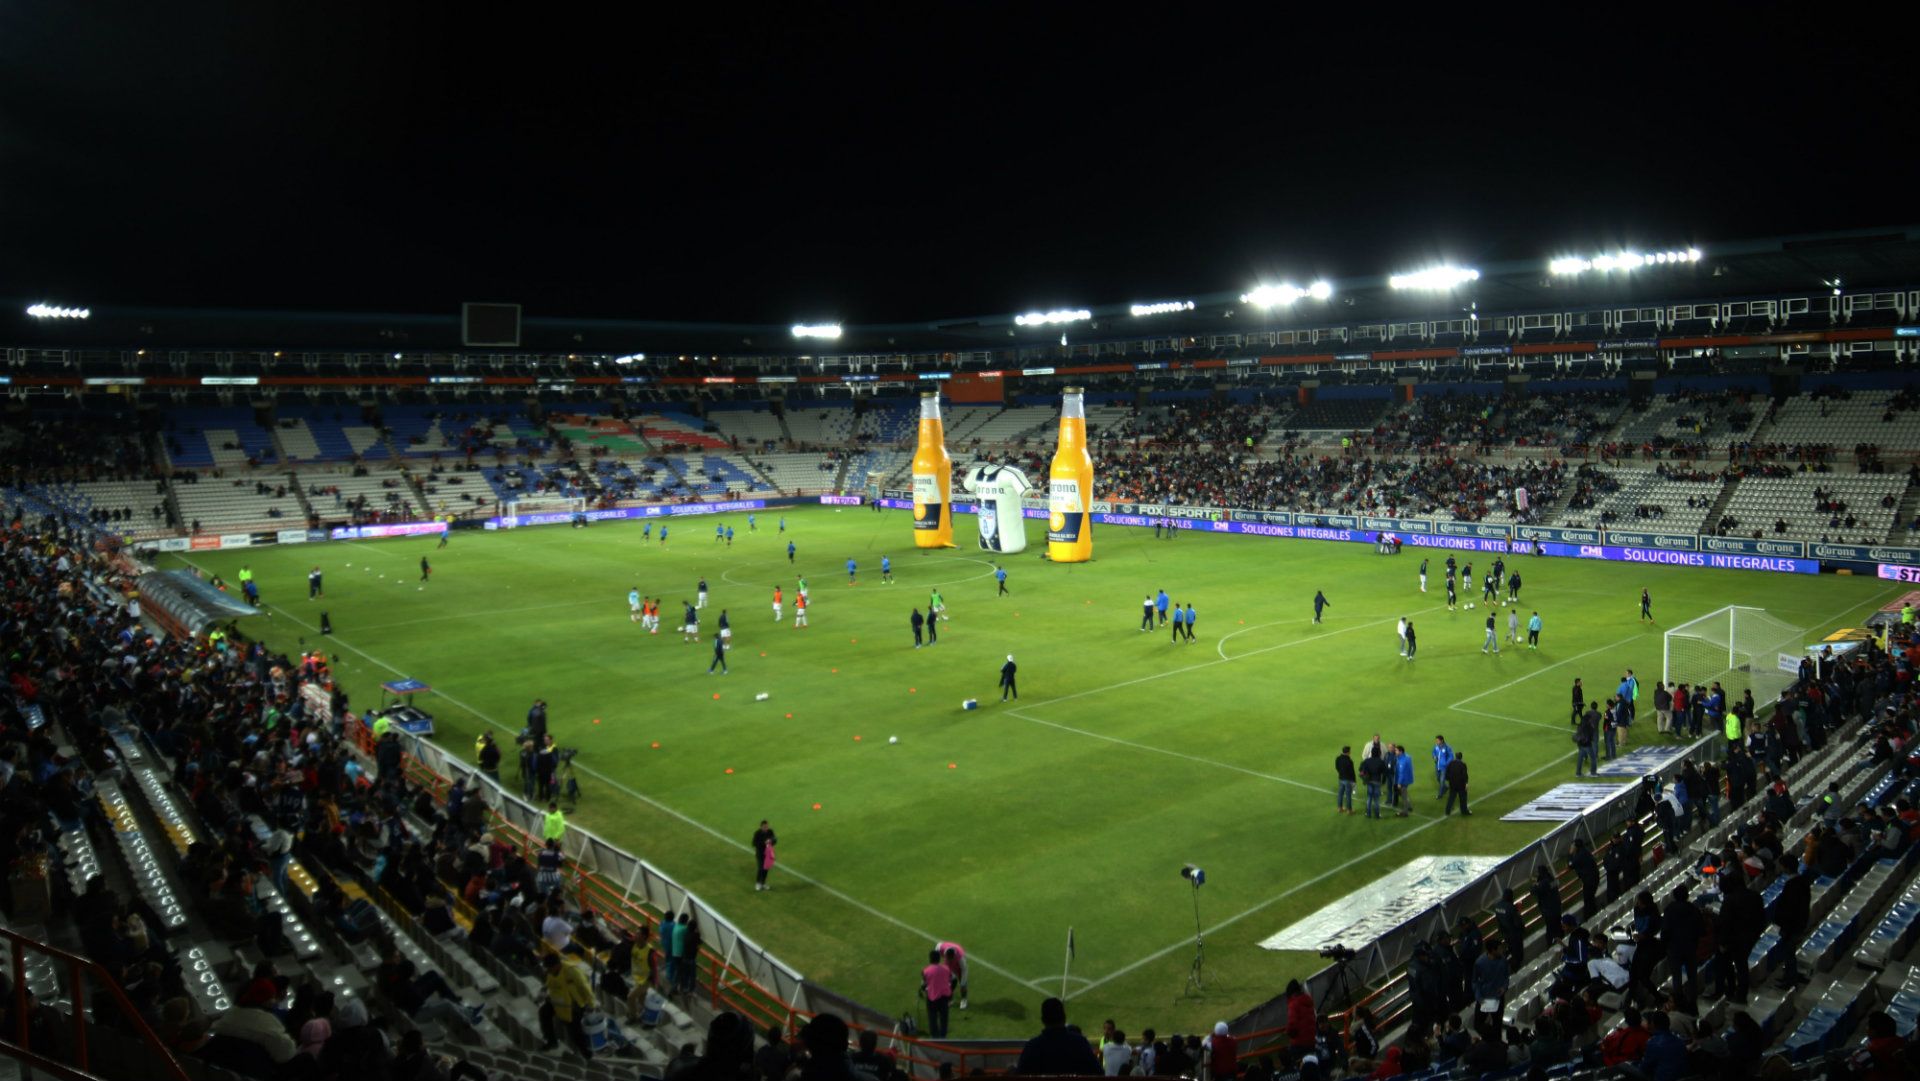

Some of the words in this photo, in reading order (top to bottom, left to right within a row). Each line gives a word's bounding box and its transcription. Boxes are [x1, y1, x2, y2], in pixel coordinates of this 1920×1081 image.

[1139, 505, 1163, 516] FOX
[1103, 514, 1145, 526] SOLUCIONES
[1400, 520, 1426, 531] Corona
[1242, 523, 1293, 536] SOLUCIONES
[1297, 527, 1350, 541] INTEGRALES
[1440, 523, 1468, 533] Corona
[1477, 525, 1506, 535] Corona
[1562, 530, 1594, 542] Corona
[1412, 534, 1475, 550] SOLUCIONES
[1610, 533, 1643, 544] Corona
[1655, 535, 1689, 547] Corona
[1707, 538, 1744, 551] Corona
[1757, 541, 1794, 553] Corona
[1580, 545, 1602, 557] CMI
[1624, 548, 1704, 566] SOLUCIONES
[1711, 555, 1794, 572] INTEGRALES
[1815, 544, 1856, 557] Corona
[1869, 548, 1912, 561] Corona
[1899, 568, 1920, 583] ST
